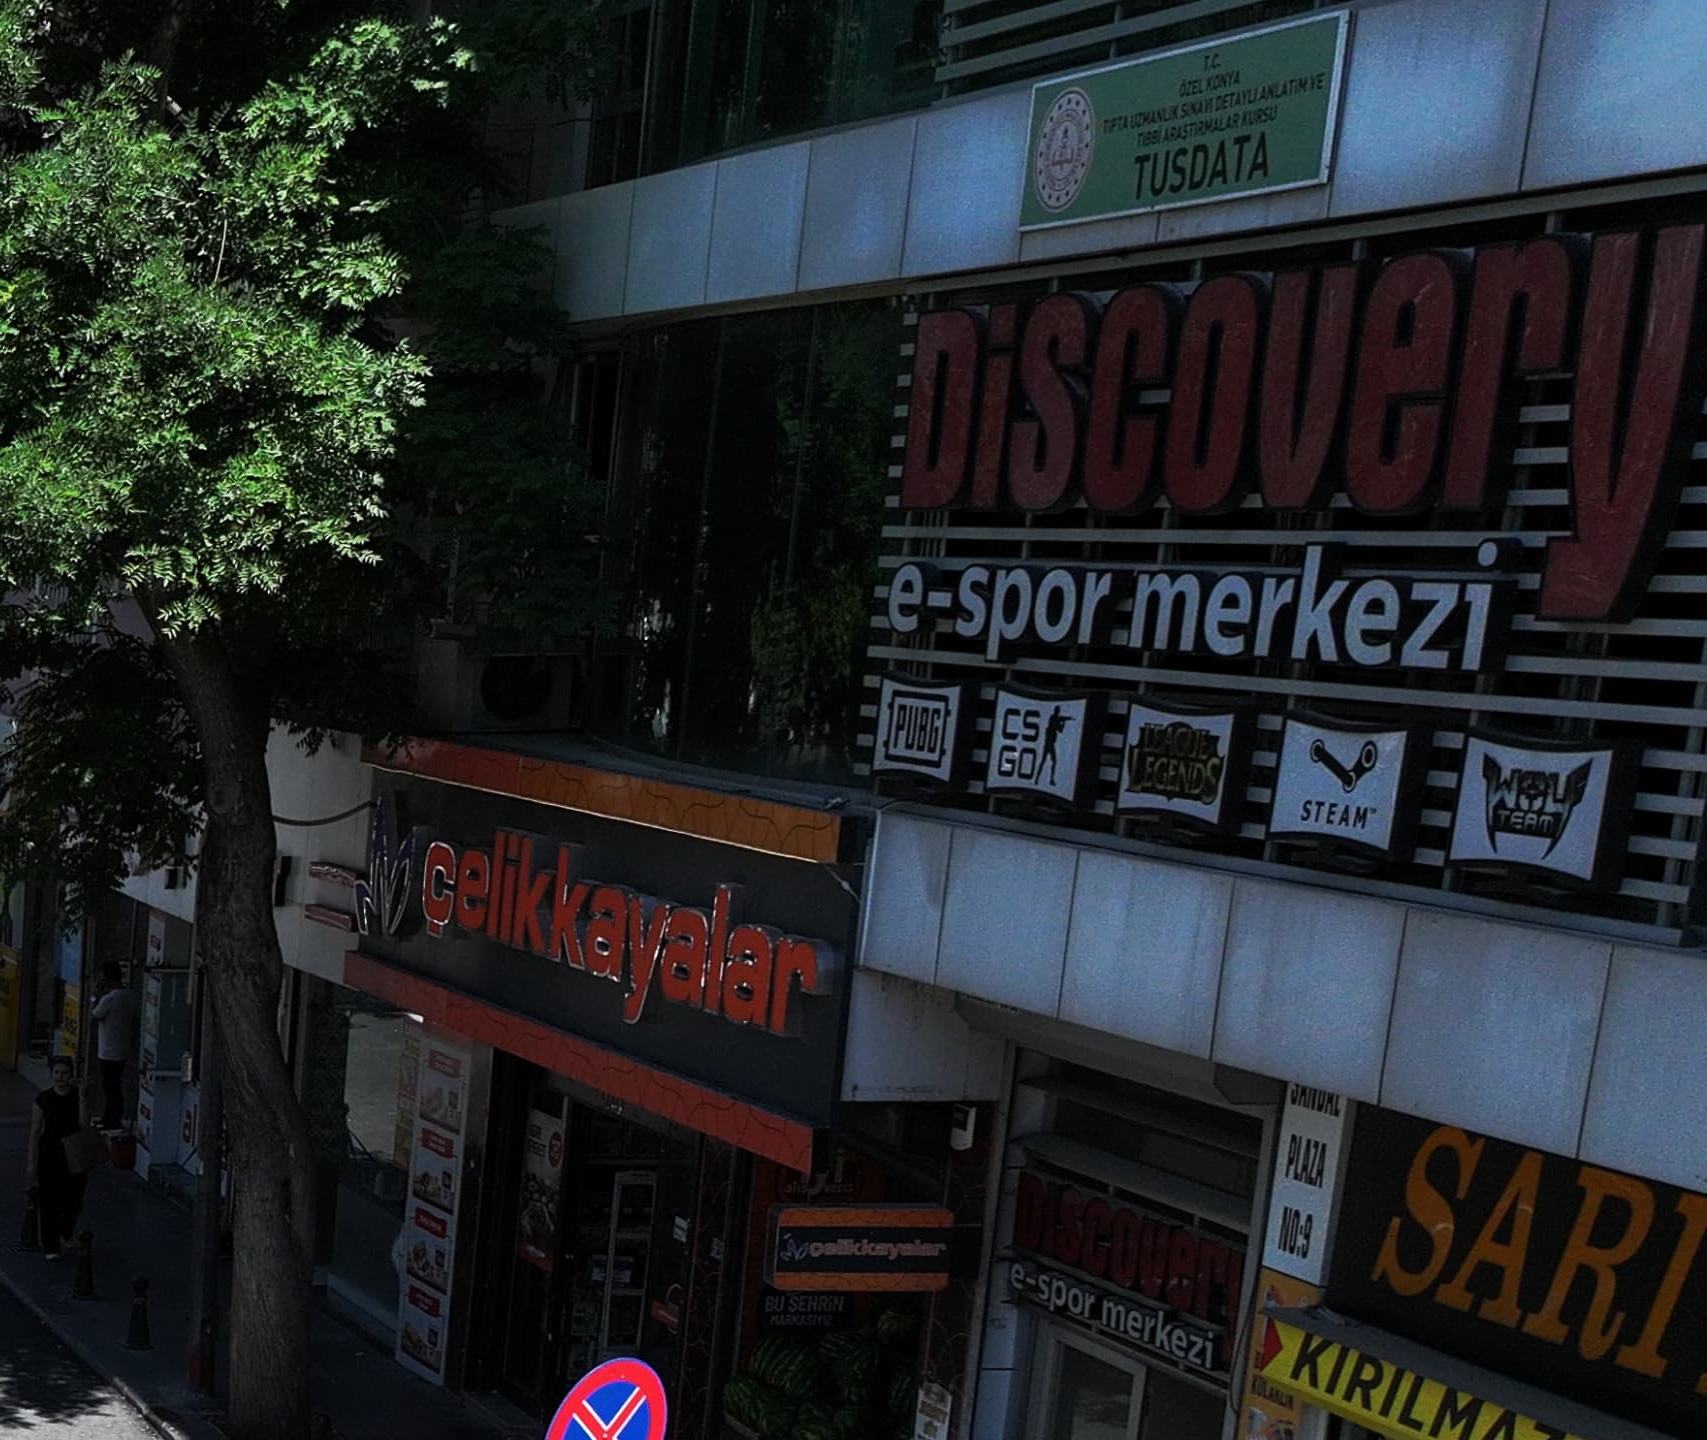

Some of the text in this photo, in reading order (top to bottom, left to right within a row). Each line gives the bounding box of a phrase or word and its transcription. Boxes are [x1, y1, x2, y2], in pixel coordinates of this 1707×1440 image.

[1179, 71, 1240, 98] ÖZEL KONYA
[1203, 54, 1221, 71] T.C.
[1130, 107, 1179, 130] UZMANLIK
[1180, 100, 1213, 119] SINAVI
[1258, 79, 1307, 101] ANLATIM
[1309, 72, 1325, 90] VE
[1241, 105, 1277, 126] KURSU
[1135, 132, 1268, 199] TUSDATA
[900, 222, 1706, 622] Discovery
[888, 538, 1501, 672] e-spor merkezi
[894, 707, 943, 756] PUBG
[1003, 708, 1040, 741] CS
[998, 747, 1038, 780] GO
[1130, 748, 1220, 804] LEGENDS
[1496, 810, 1554, 833] TEAM
[422, 829, 819, 1037] çelikkayalar
[1287, 1134, 1326, 1188] PLAZA
[1278, 1207, 1313, 1260] NO:9
[1373, 1123, 1707, 1396] SARI
[1010, 1262, 1215, 1370] e-spor merkezi
